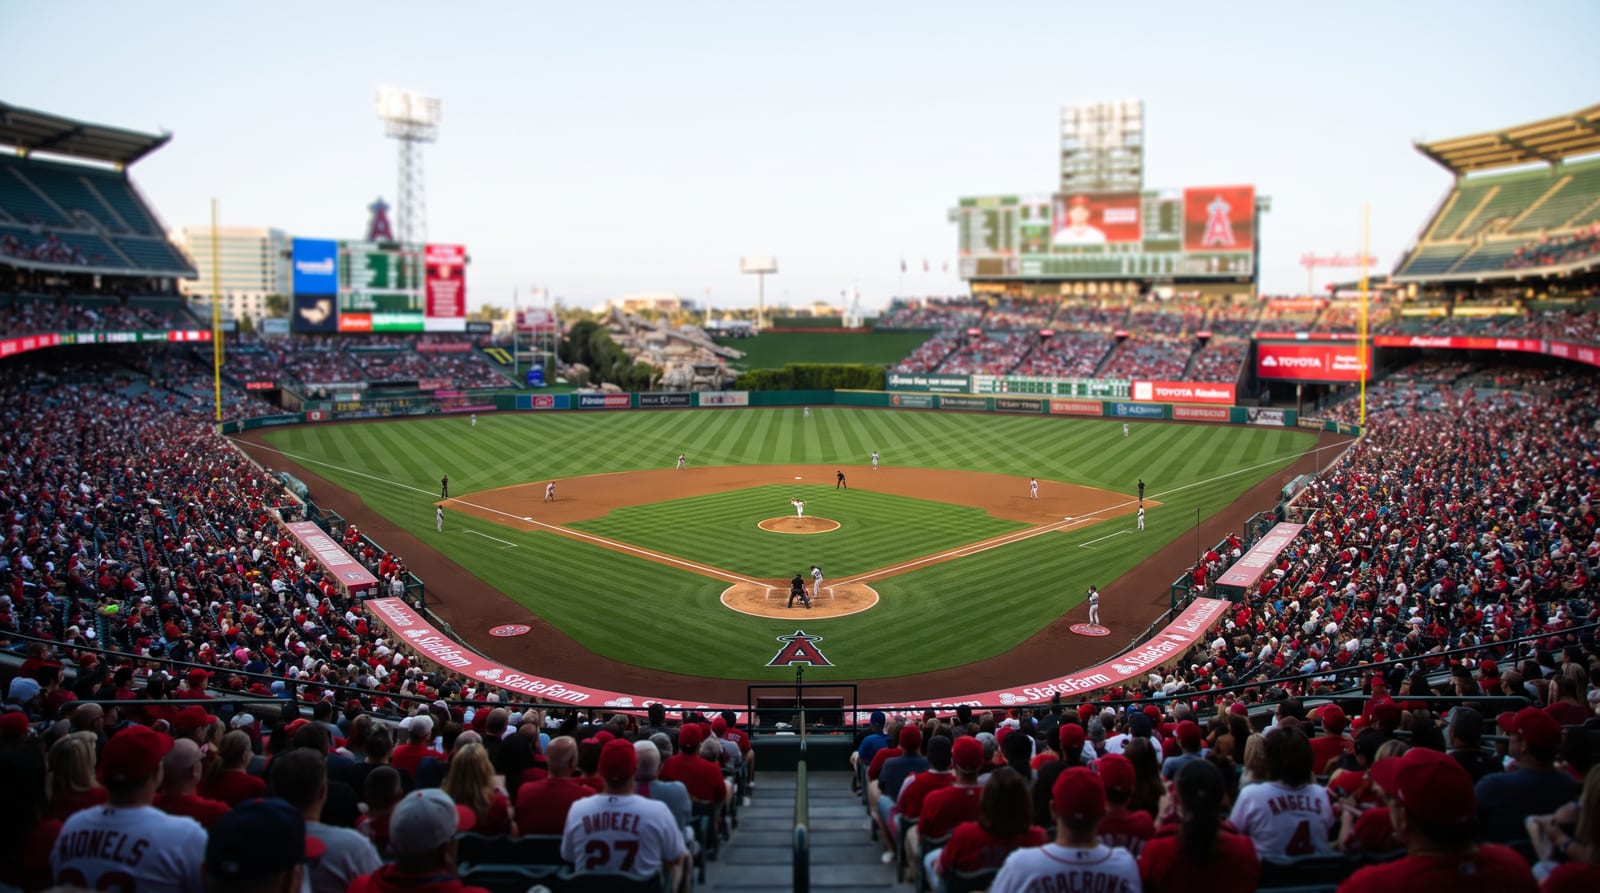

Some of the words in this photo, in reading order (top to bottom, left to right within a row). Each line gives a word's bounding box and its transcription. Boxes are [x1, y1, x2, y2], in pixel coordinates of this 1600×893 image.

[1277, 356, 1321, 368] TOYOTA
[1155, 388, 1193, 397] TOYOTA
[764, 630, 836, 666] A
[1285, 820, 1315, 855] 4
[585, 839, 640, 871] 27
